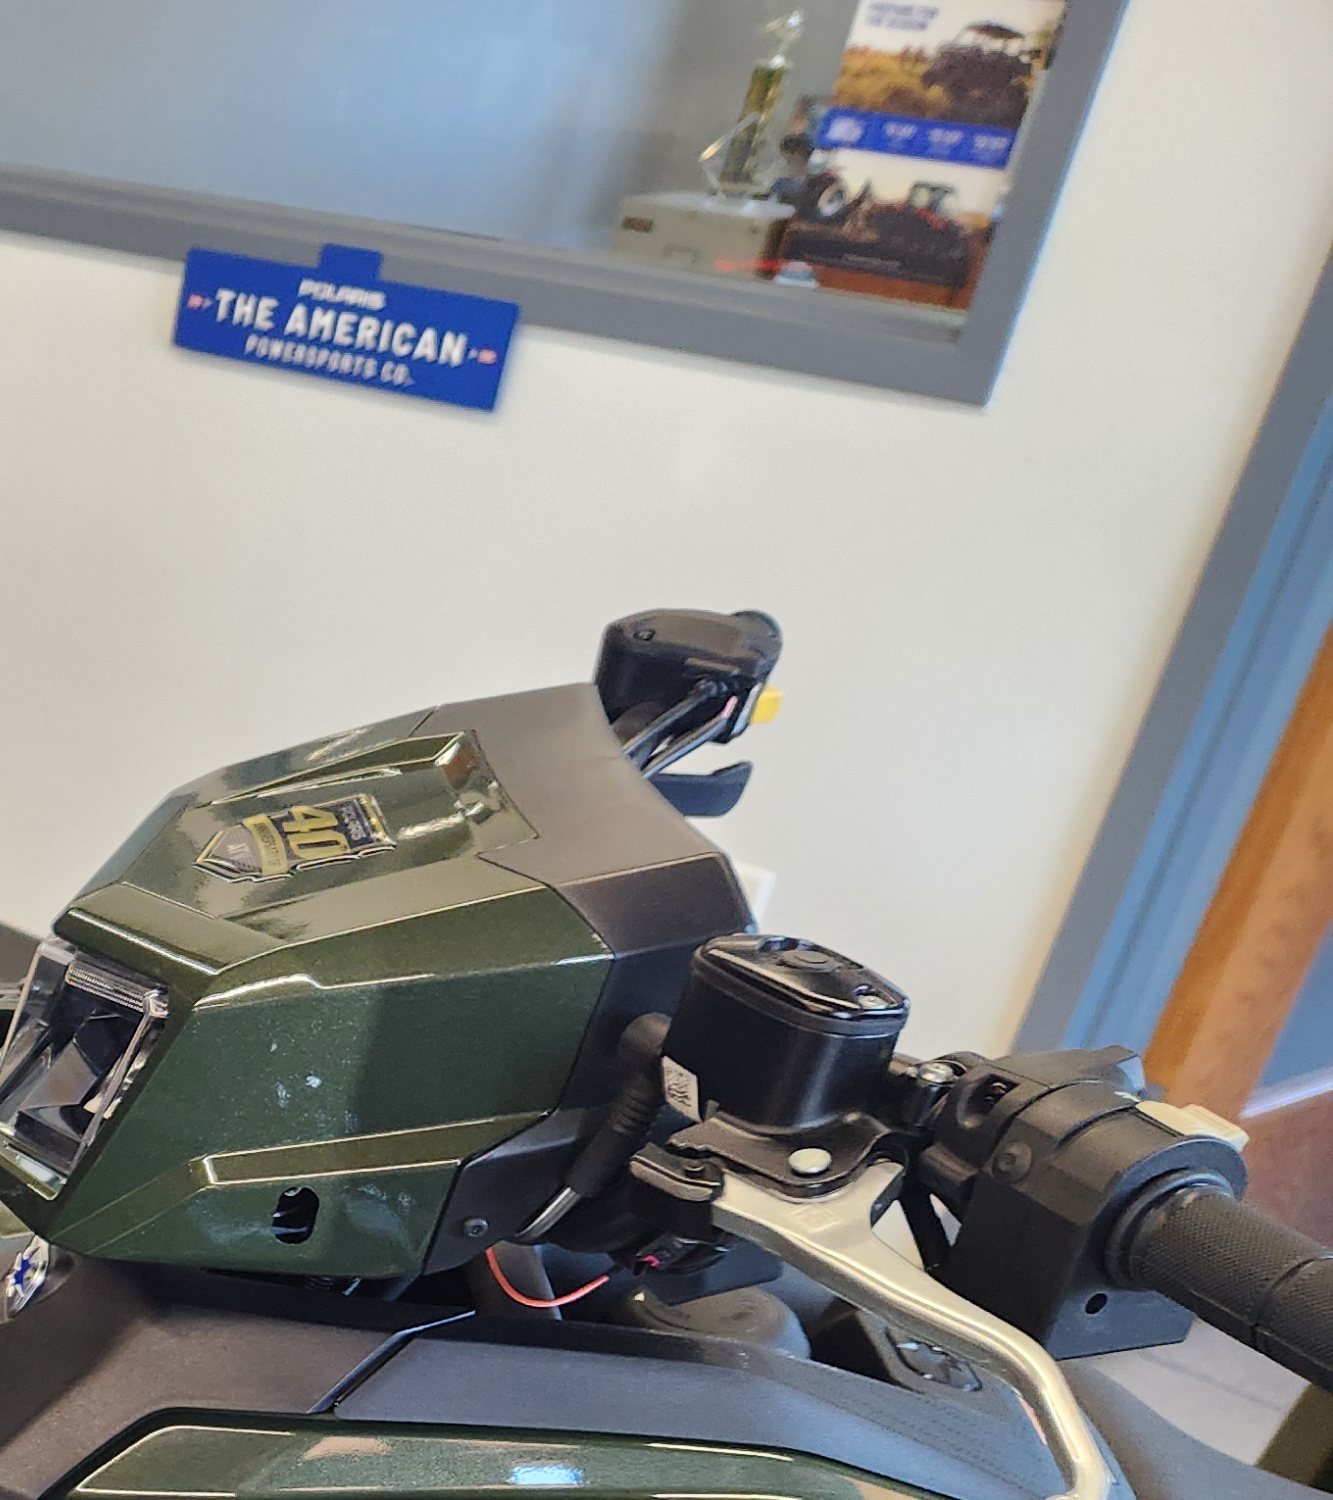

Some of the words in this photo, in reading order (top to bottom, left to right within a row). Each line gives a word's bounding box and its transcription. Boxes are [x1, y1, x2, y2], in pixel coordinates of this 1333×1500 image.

[214, 287, 280, 332] THE
[283, 303, 469, 368] AMERICAN
[244, 333, 378, 379] POWERSPORTS
[282, 805, 351, 860] 40
